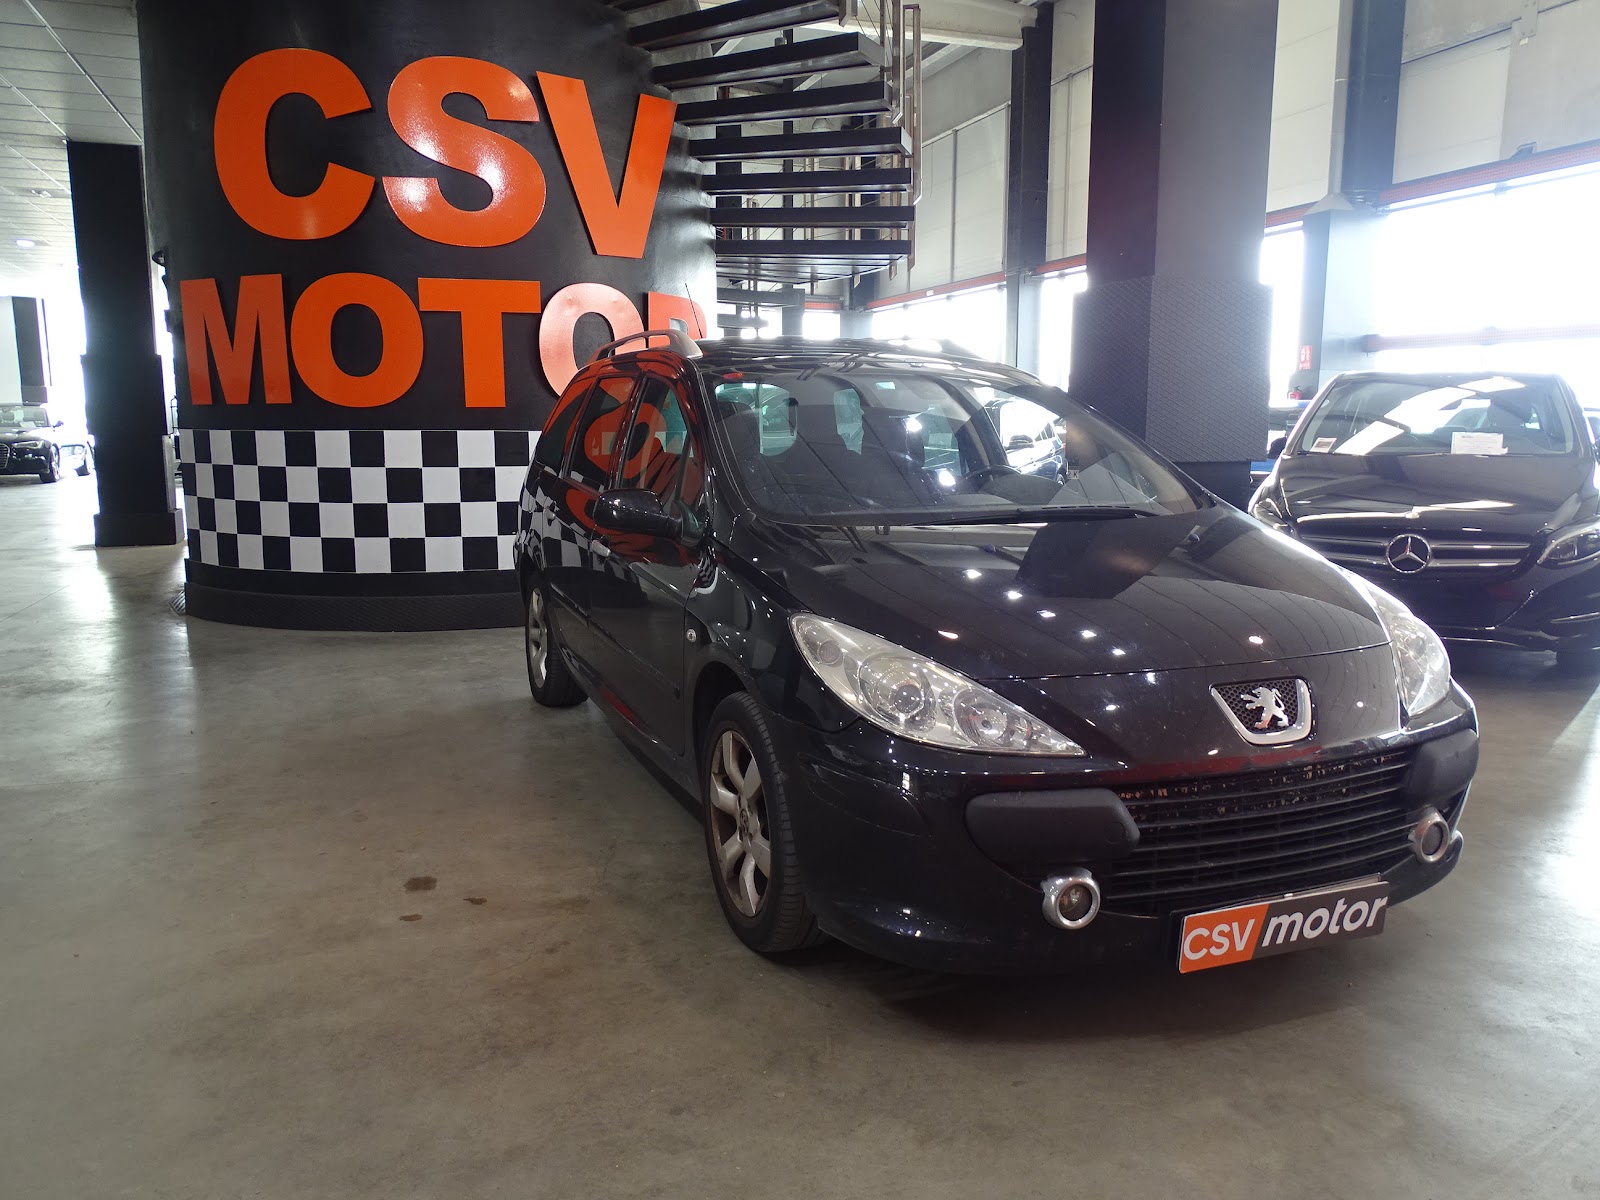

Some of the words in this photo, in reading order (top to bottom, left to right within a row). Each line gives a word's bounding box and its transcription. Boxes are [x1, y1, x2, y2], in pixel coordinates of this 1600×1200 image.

[214, 48, 677, 259] CSV
[1183, 918, 1256, 961] CSV
[1261, 896, 1389, 947] motor
